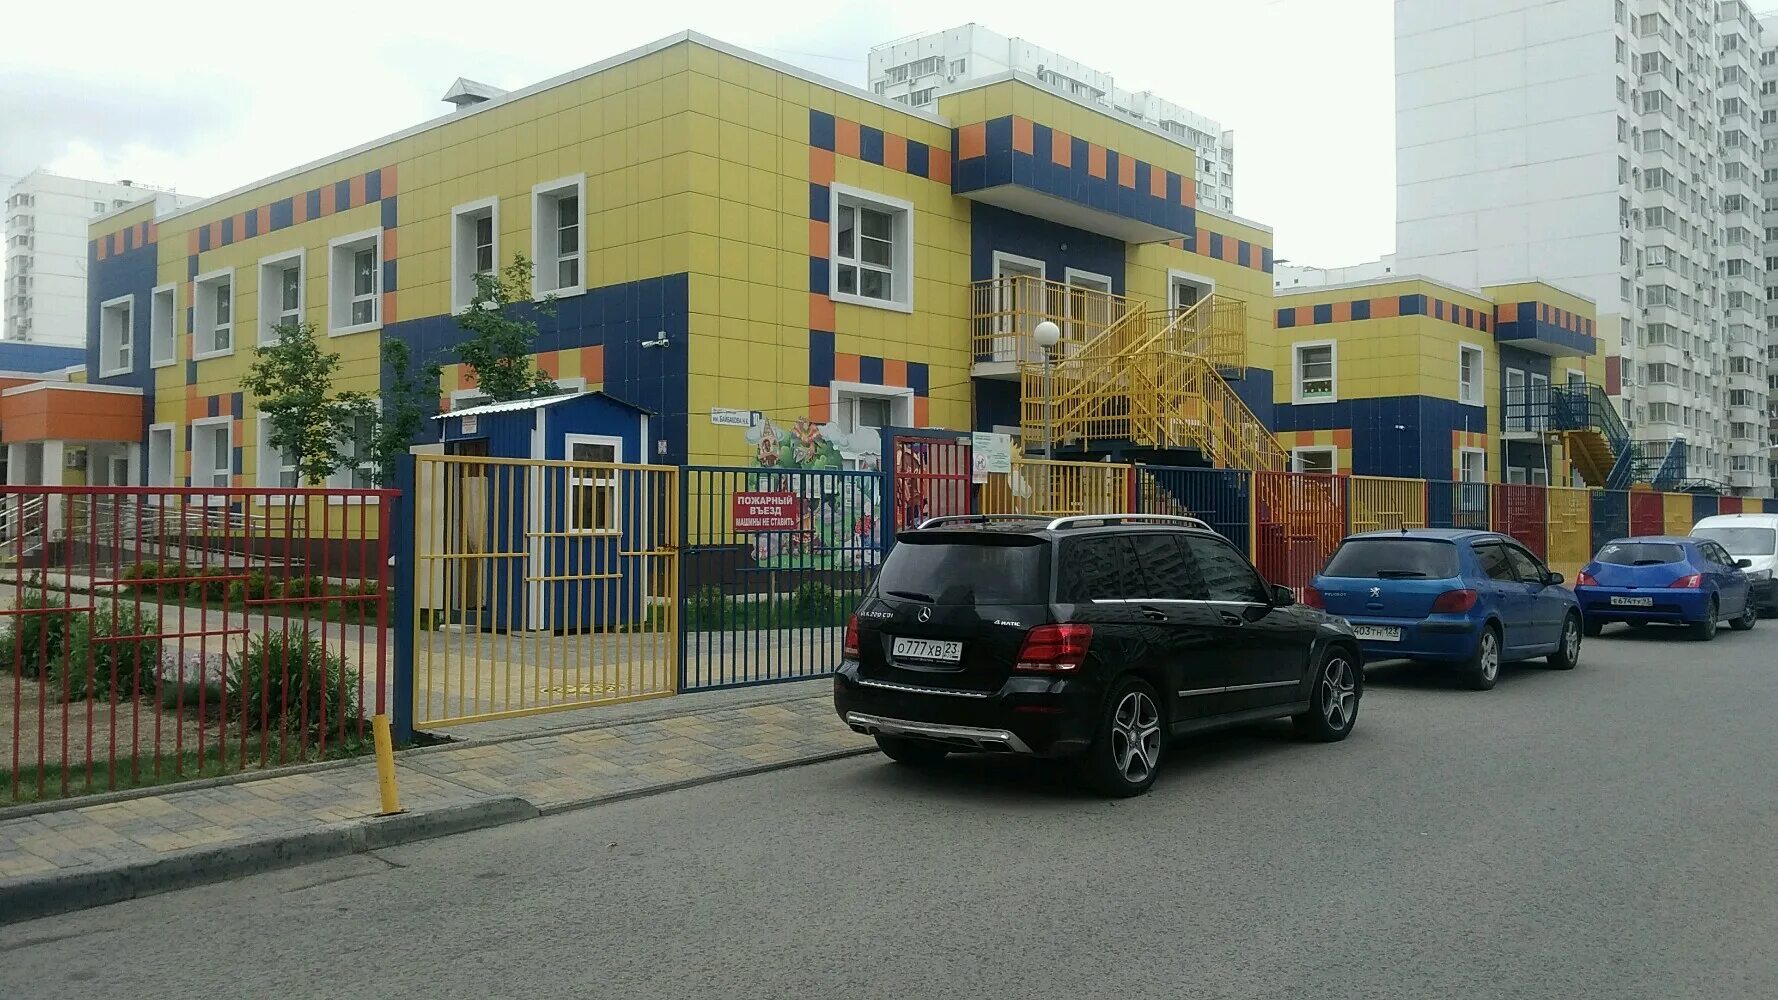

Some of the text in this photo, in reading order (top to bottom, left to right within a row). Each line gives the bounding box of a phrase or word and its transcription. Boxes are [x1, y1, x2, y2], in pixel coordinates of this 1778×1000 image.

[737, 495, 793, 505] ПОЖАРНЫЙ
[749, 506, 782, 517] ВЪЕЗД
[735, 517, 795, 527] МАШИНЫ НЕ СТАВИТЬ
[1353, 625, 1382, 637] 403ТН
[944, 642, 958, 654] 23
